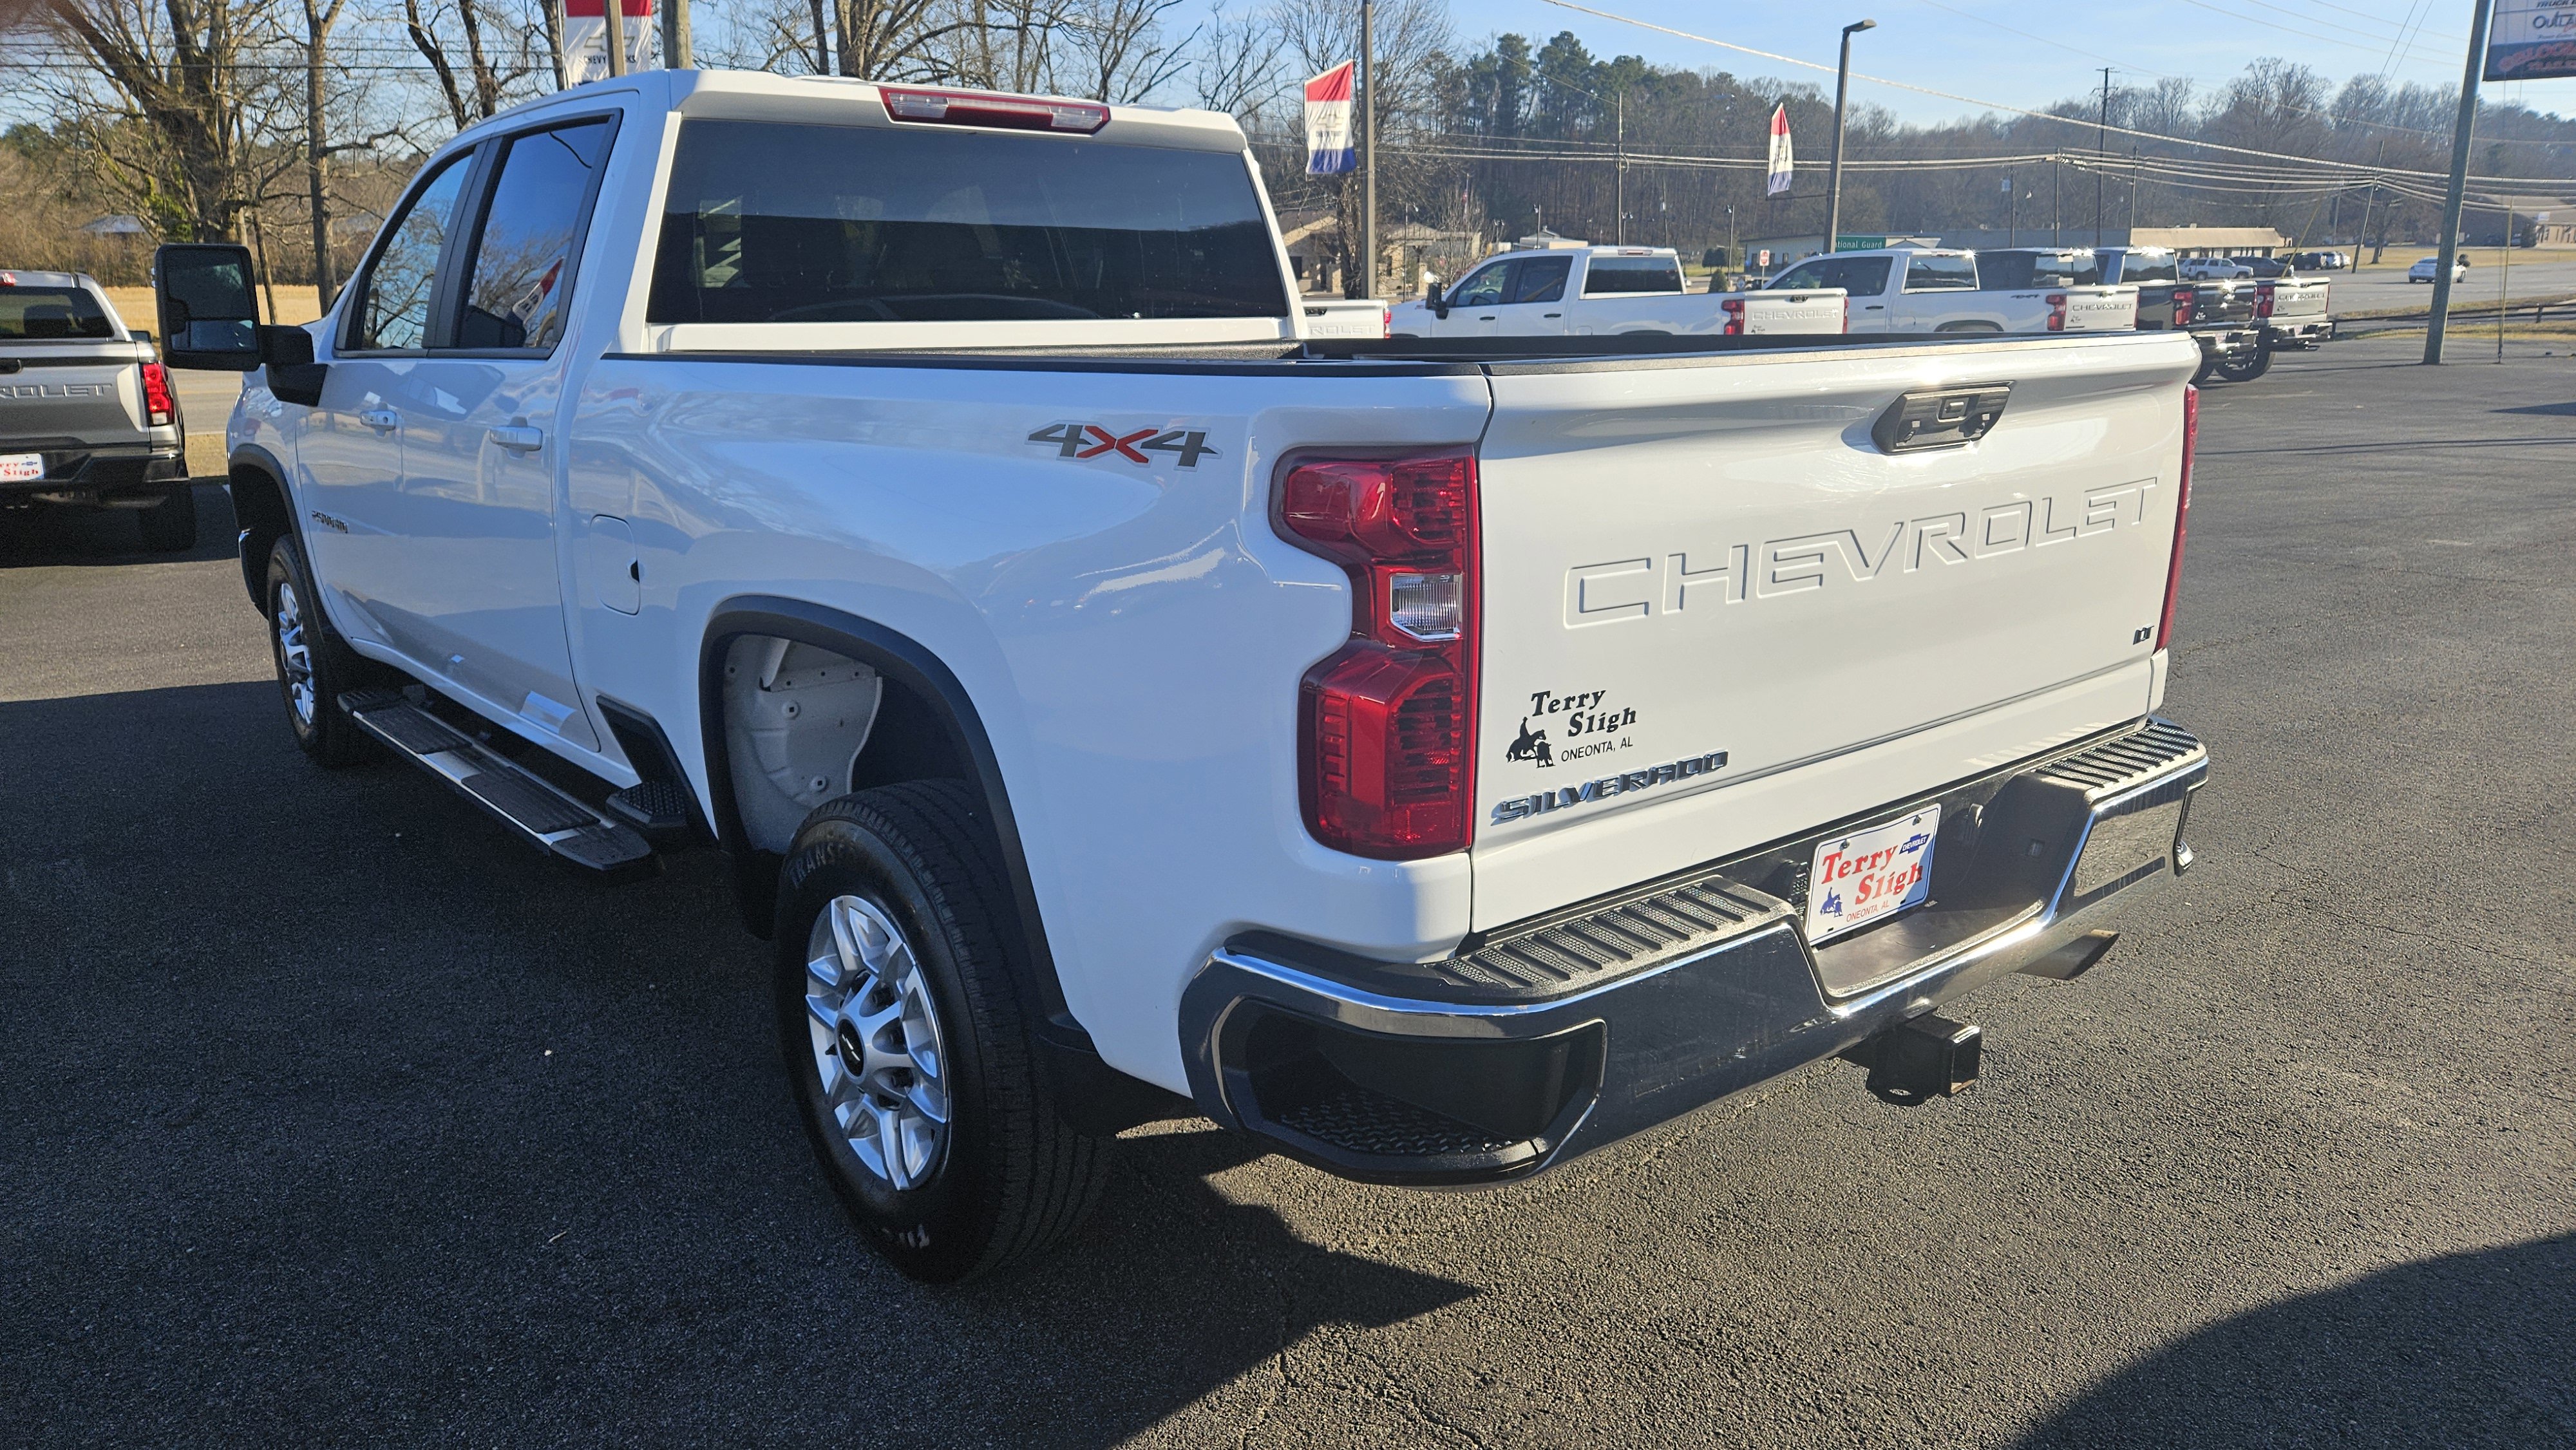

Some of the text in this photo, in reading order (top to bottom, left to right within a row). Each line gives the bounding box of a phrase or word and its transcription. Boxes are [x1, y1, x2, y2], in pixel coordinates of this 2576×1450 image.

[1835, 240, 1858, 249] tional
[1564, 476, 2157, 630] CHEVROLET
[1531, 690, 1606, 717] Terry
[1567, 707, 1636, 737] Sligh
[1561, 737, 1633, 762] ONEONTA, AL
[1494, 749, 1728, 822] SILVERADO
[1902, 836, 1927, 851] CHEVROLET
[1821, 845, 1898, 885] Terry
[1855, 862, 1923, 905] Sligh
[1846, 899, 1889, 923] ONEONTA, AL
